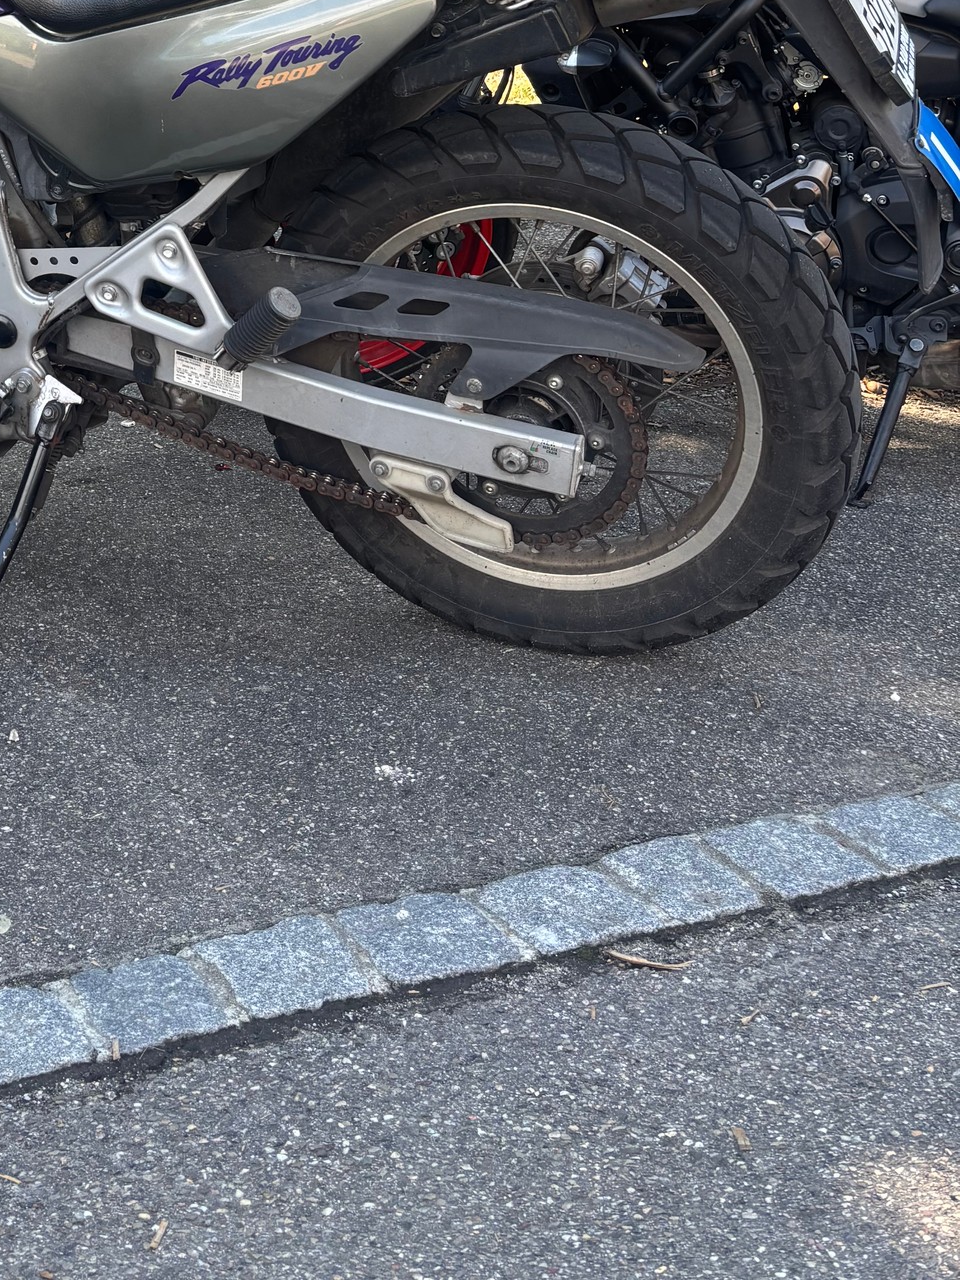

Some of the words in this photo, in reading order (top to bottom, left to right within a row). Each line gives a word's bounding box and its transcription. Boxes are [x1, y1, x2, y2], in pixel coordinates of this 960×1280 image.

[171, 54, 262, 100] Rally
[263, 33, 364, 75] Touring
[256, 61, 327, 89] 600V
[667, 241, 787, 413] METZELER
